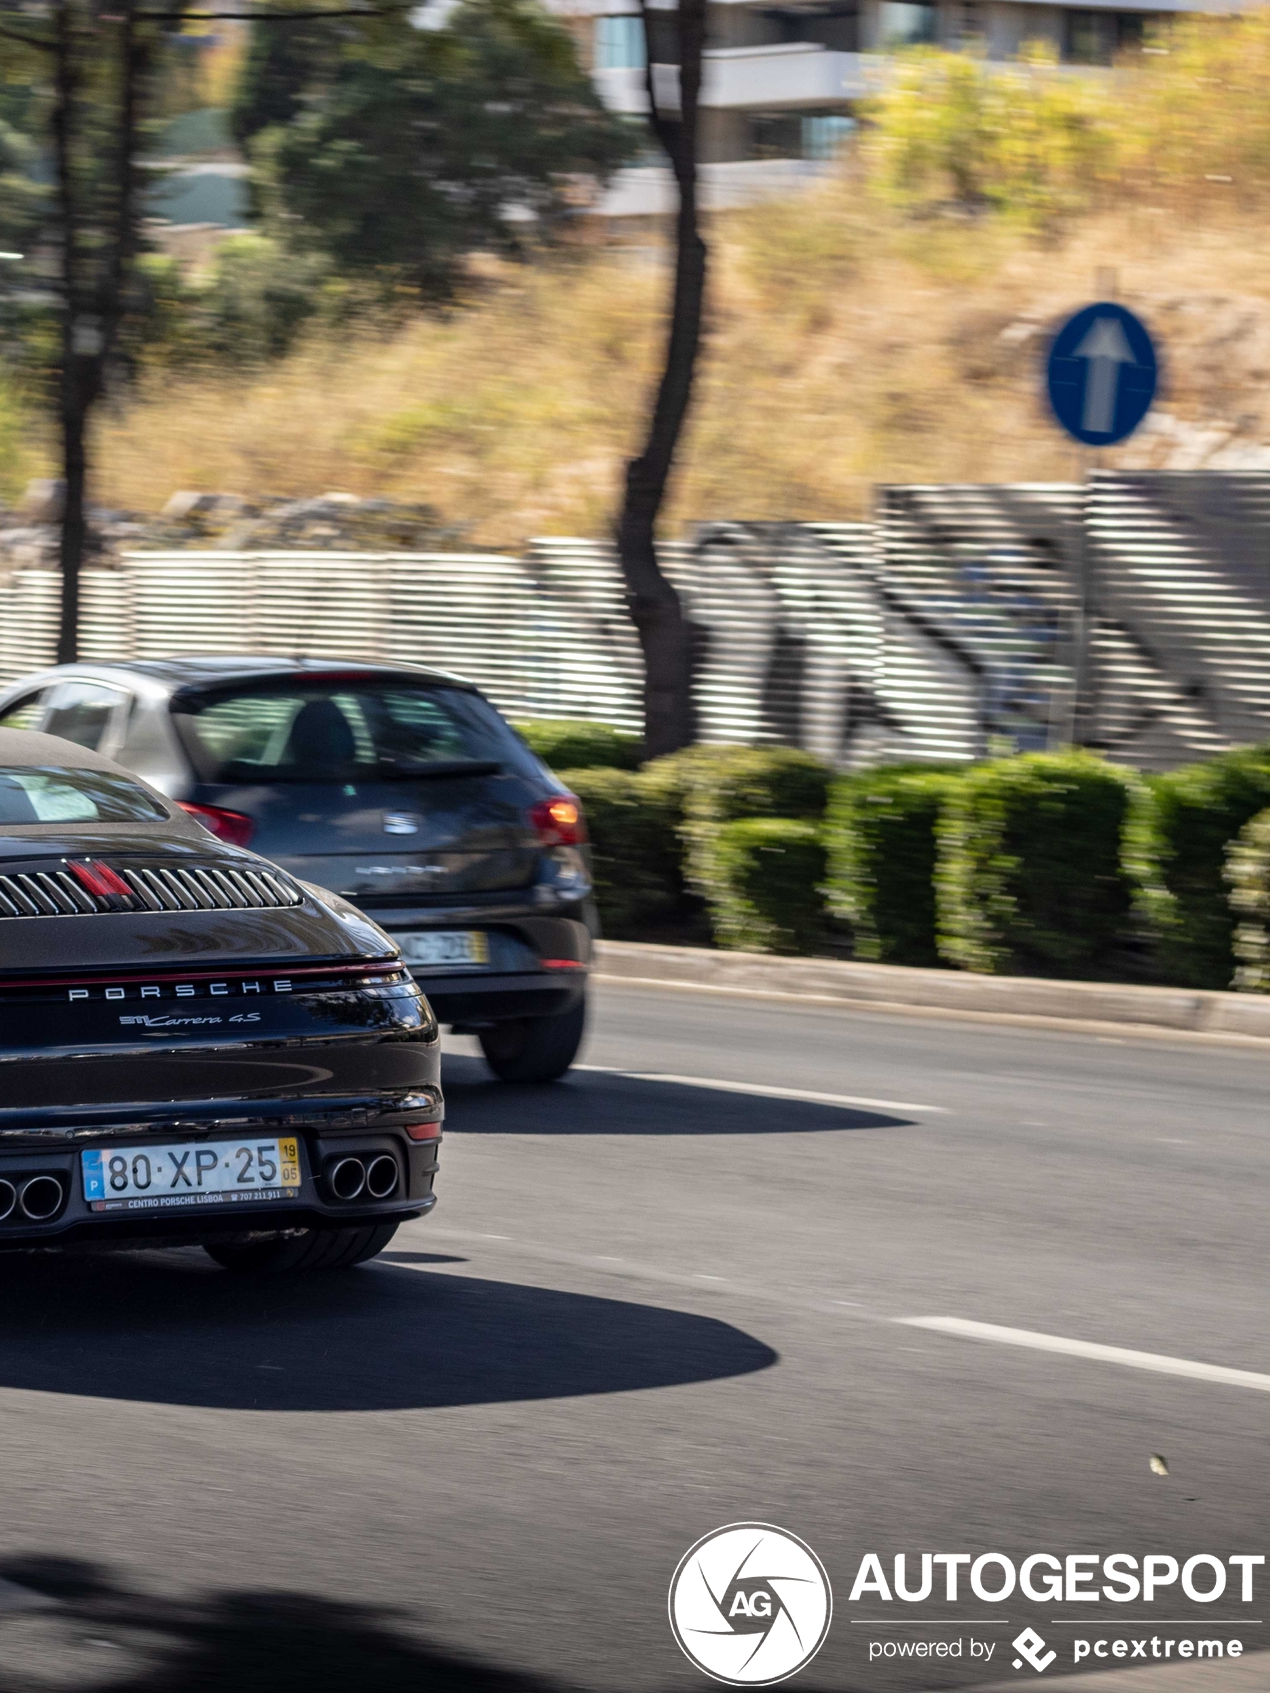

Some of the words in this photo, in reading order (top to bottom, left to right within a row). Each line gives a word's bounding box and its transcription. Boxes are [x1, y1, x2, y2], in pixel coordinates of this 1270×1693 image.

[68, 979, 293, 1001] PORSCHE
[146, 1015, 222, 1027] Carrera
[229, 1012, 261, 1022] 4S
[283, 1144, 296, 1157] 19
[282, 1167, 297, 1181] 05
[90, 1180, 98, 1191] P
[128, 1199, 159, 1209] CENTRO
[160, 1196, 195, 1207] PORSCHE
[196, 1194, 223, 1204] LISBOA
[239, 1192, 252, 1200] 707
[253, 1191, 267, 1199] 211
[268, 1191, 281, 1199] 911
